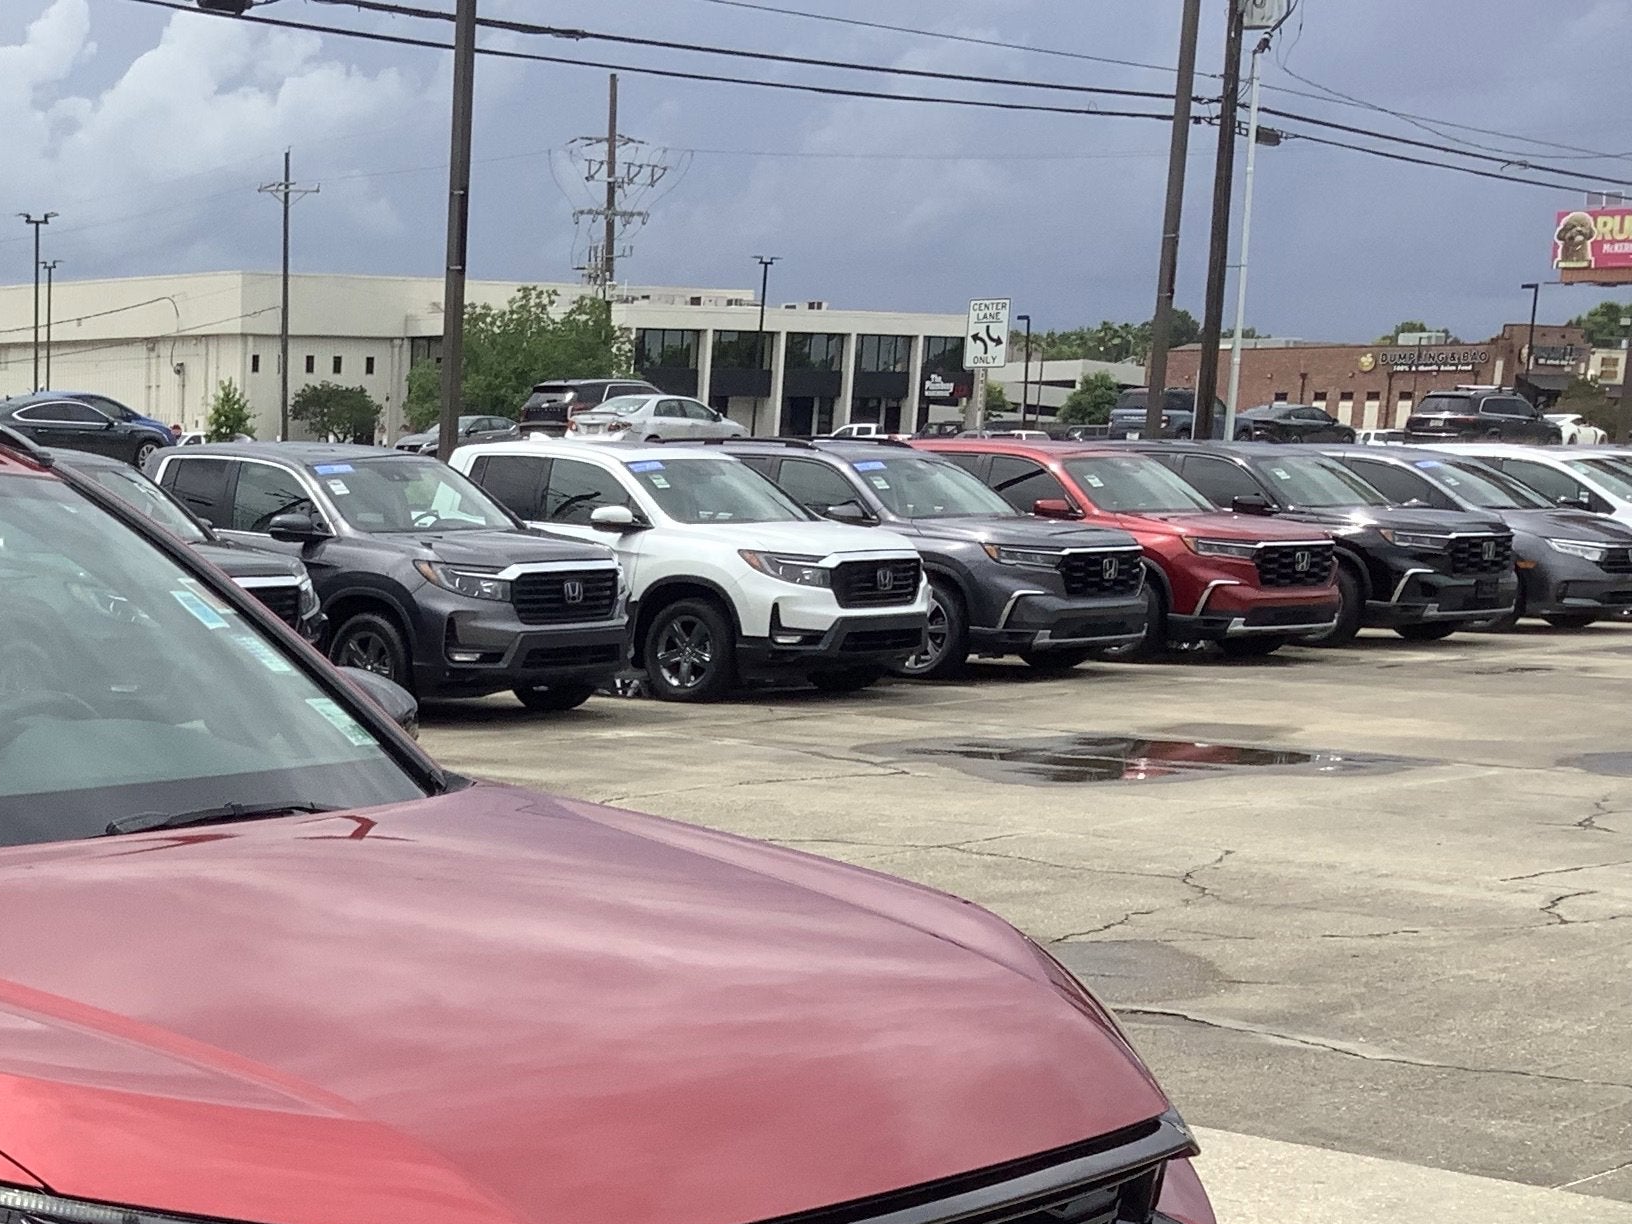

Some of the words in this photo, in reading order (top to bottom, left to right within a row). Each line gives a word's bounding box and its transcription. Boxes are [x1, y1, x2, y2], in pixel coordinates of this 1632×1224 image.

[1596, 215, 1632, 240] RU
[972, 302, 1007, 311] CENTER
[976, 312, 1001, 321] LANE
[973, 356, 997, 365] ONLY
[1380, 351, 1445, 364] DUMPING
[1461, 351, 1488, 363] BAO
